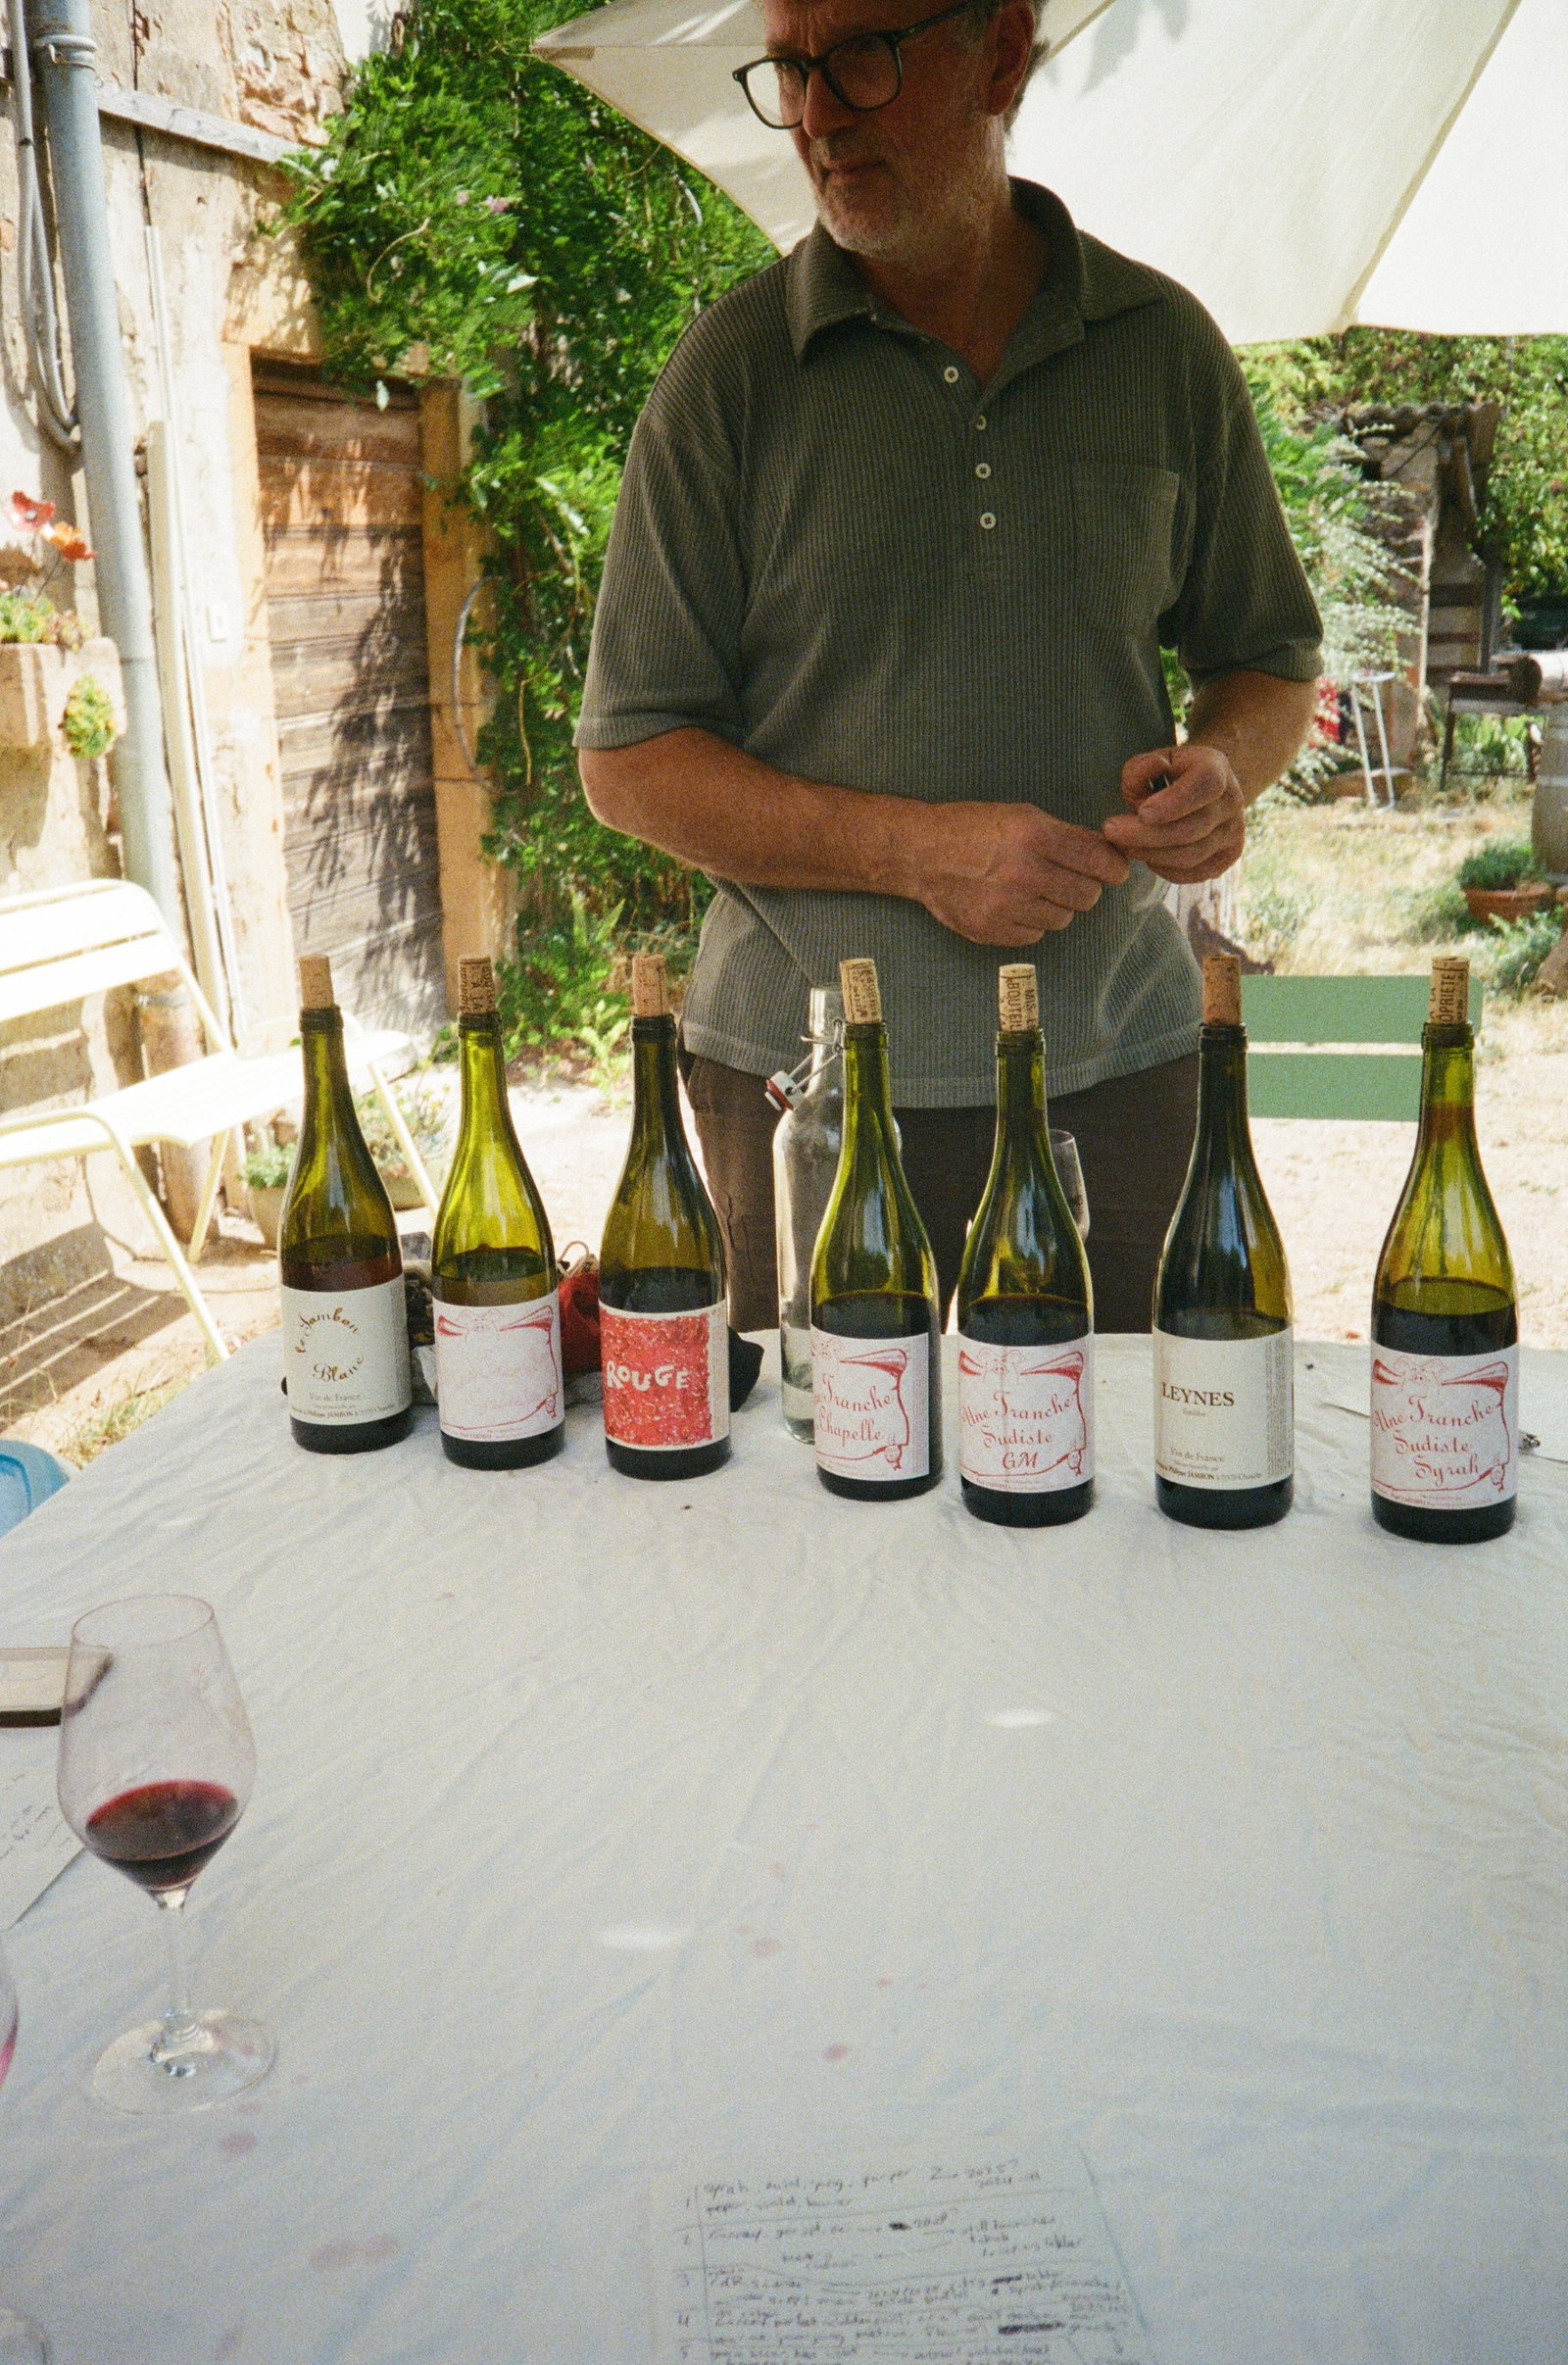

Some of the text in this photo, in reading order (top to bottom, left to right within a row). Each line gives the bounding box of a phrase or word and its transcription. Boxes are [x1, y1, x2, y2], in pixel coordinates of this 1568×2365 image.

[313, 1355, 365, 1382] Blanc
[606, 1359, 691, 1392] ROUGE
[334, 1393, 362, 1402] France
[822, 1372, 892, 1412] Tranche
[993, 1390, 1071, 1420] Tranche
[1160, 1381, 1236, 1407] LEYNES
[1407, 1395, 1493, 1427] Tranche
[980, 1425, 1054, 1450] Sudiste
[1393, 1429, 1469, 1454] Sudiste
[1002, 1452, 1039, 1470] GM
[1196, 1453, 1225, 1463] France
[1413, 1453, 1480, 1487] Syrah
